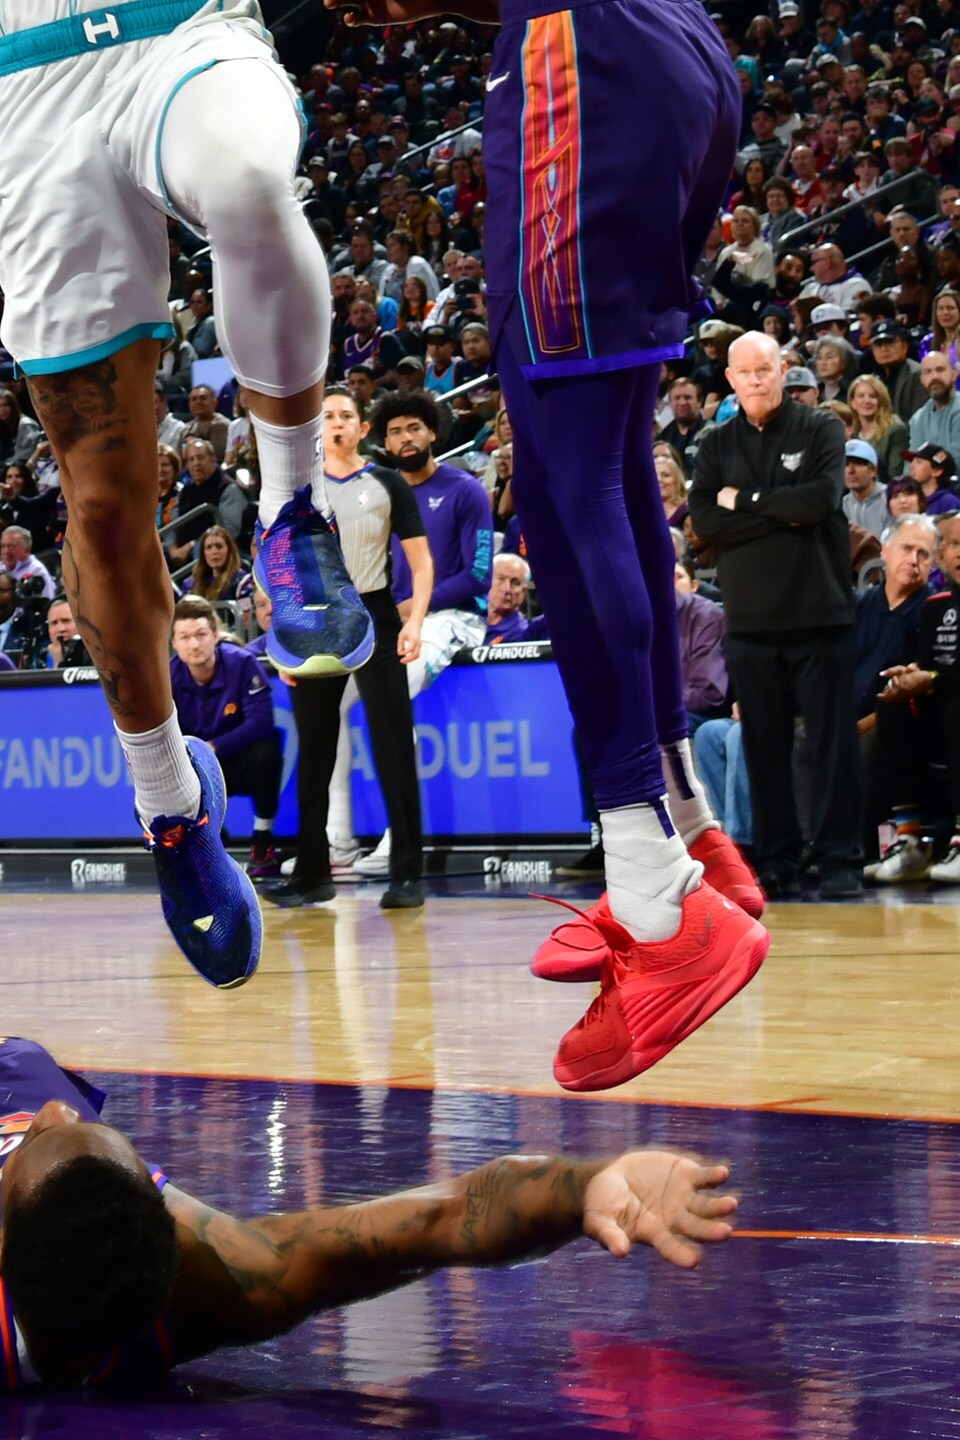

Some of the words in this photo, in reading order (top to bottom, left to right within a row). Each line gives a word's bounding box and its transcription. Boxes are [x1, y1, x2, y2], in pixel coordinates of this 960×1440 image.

[488, 645, 541, 660] FANDUEL
[84, 862, 126, 876] FANDUEL
[500, 860, 553, 876] FANDUEL
